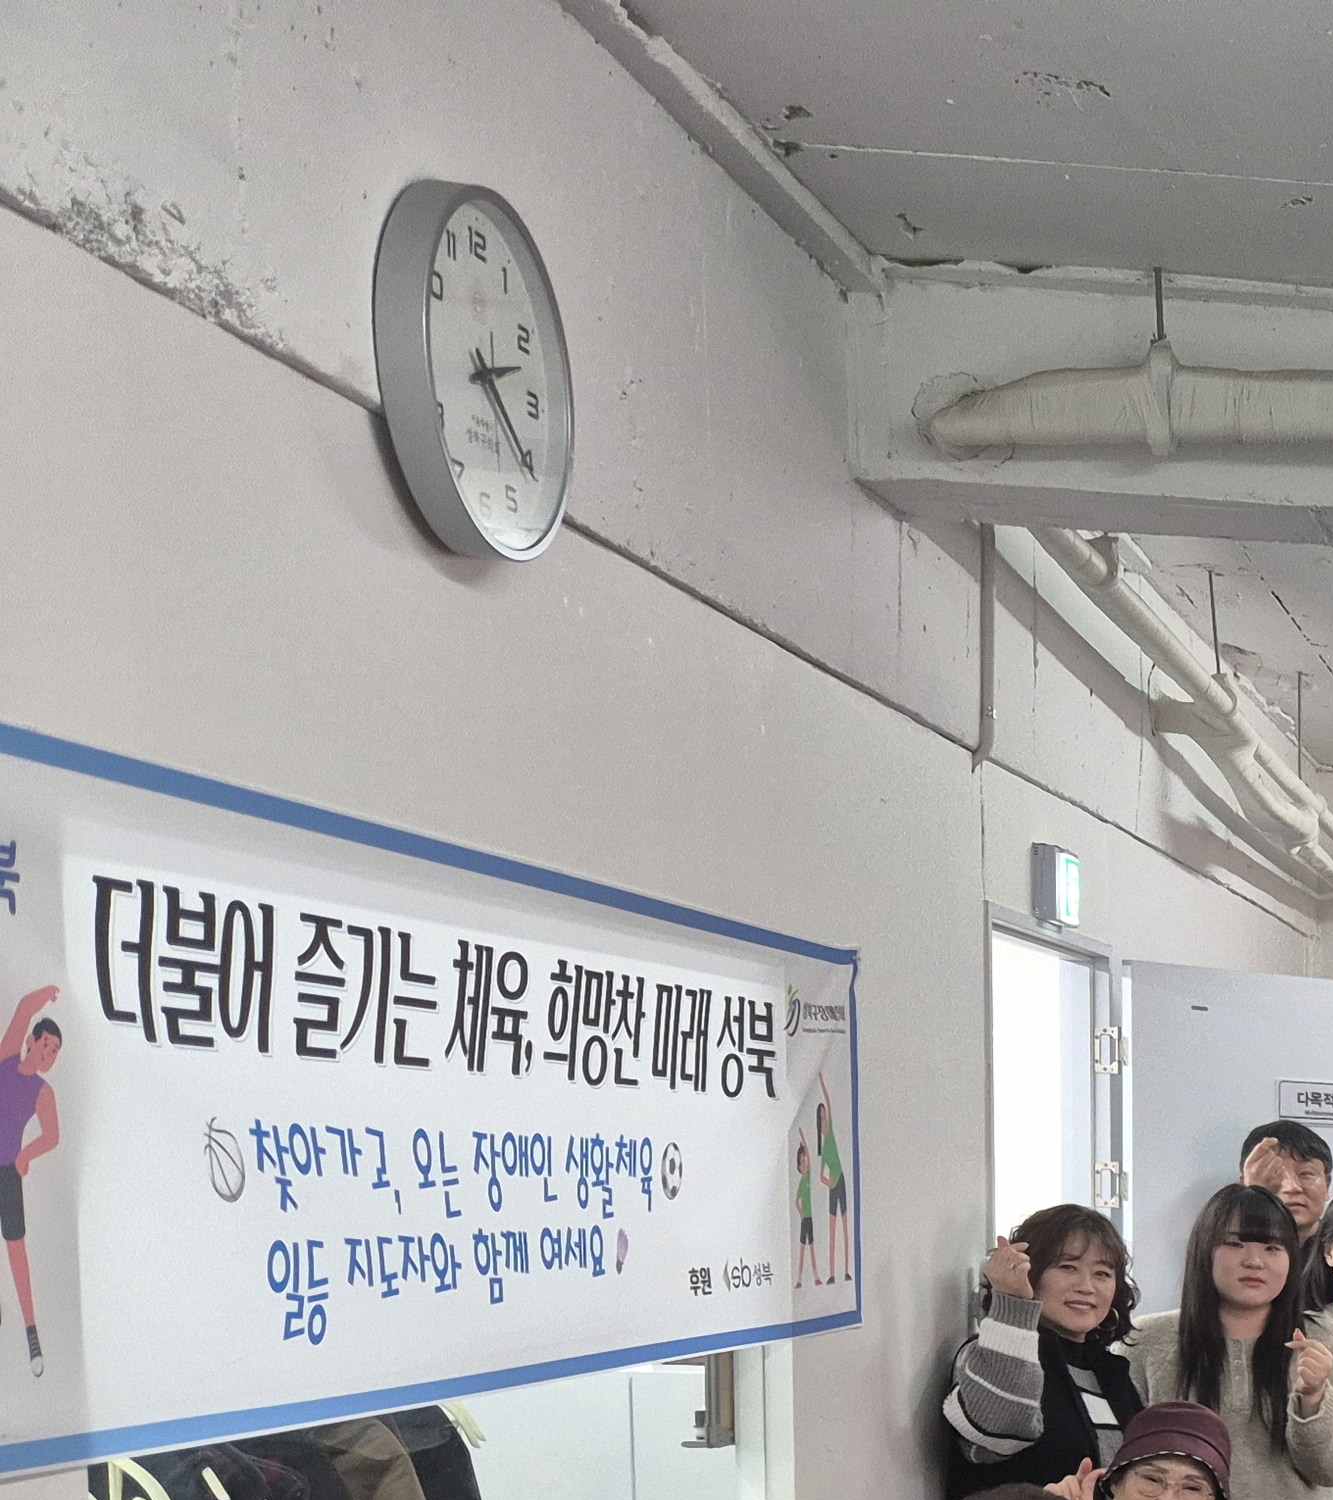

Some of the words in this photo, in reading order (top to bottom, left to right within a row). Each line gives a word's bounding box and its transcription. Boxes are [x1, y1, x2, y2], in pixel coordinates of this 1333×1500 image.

[446, 228, 456, 262] 11
[468, 225, 487, 264] 12
[430, 270, 443, 301] 0
[502, 267, 508, 294] 1
[517, 323, 531, 356] 2
[526, 390, 540, 420] 3
[505, 483, 518, 513] 5
[92, 875, 275, 1054] 더불어
[293, 912, 438, 1068] 즐기는
[445, 938, 533, 1076] 체육,
[543, 958, 646, 1087] 희망찬
[652, 983, 713, 1093] 미래
[717, 995, 777, 1099] 성북
[249, 1119, 402, 1215] 찾아가고,
[412, 1128, 462, 1218] 오는
[472, 1131, 557, 1213] 장애인
[565, 1133, 653, 1219] 생활체육
[267, 1239, 329, 1346] 일등
[344, 1232, 463, 1299] 지도자와
[472, 1227, 530, 1305] 함께
[540, 1224, 606, 1278] 여세요
[688, 1267, 713, 1297] 후원
